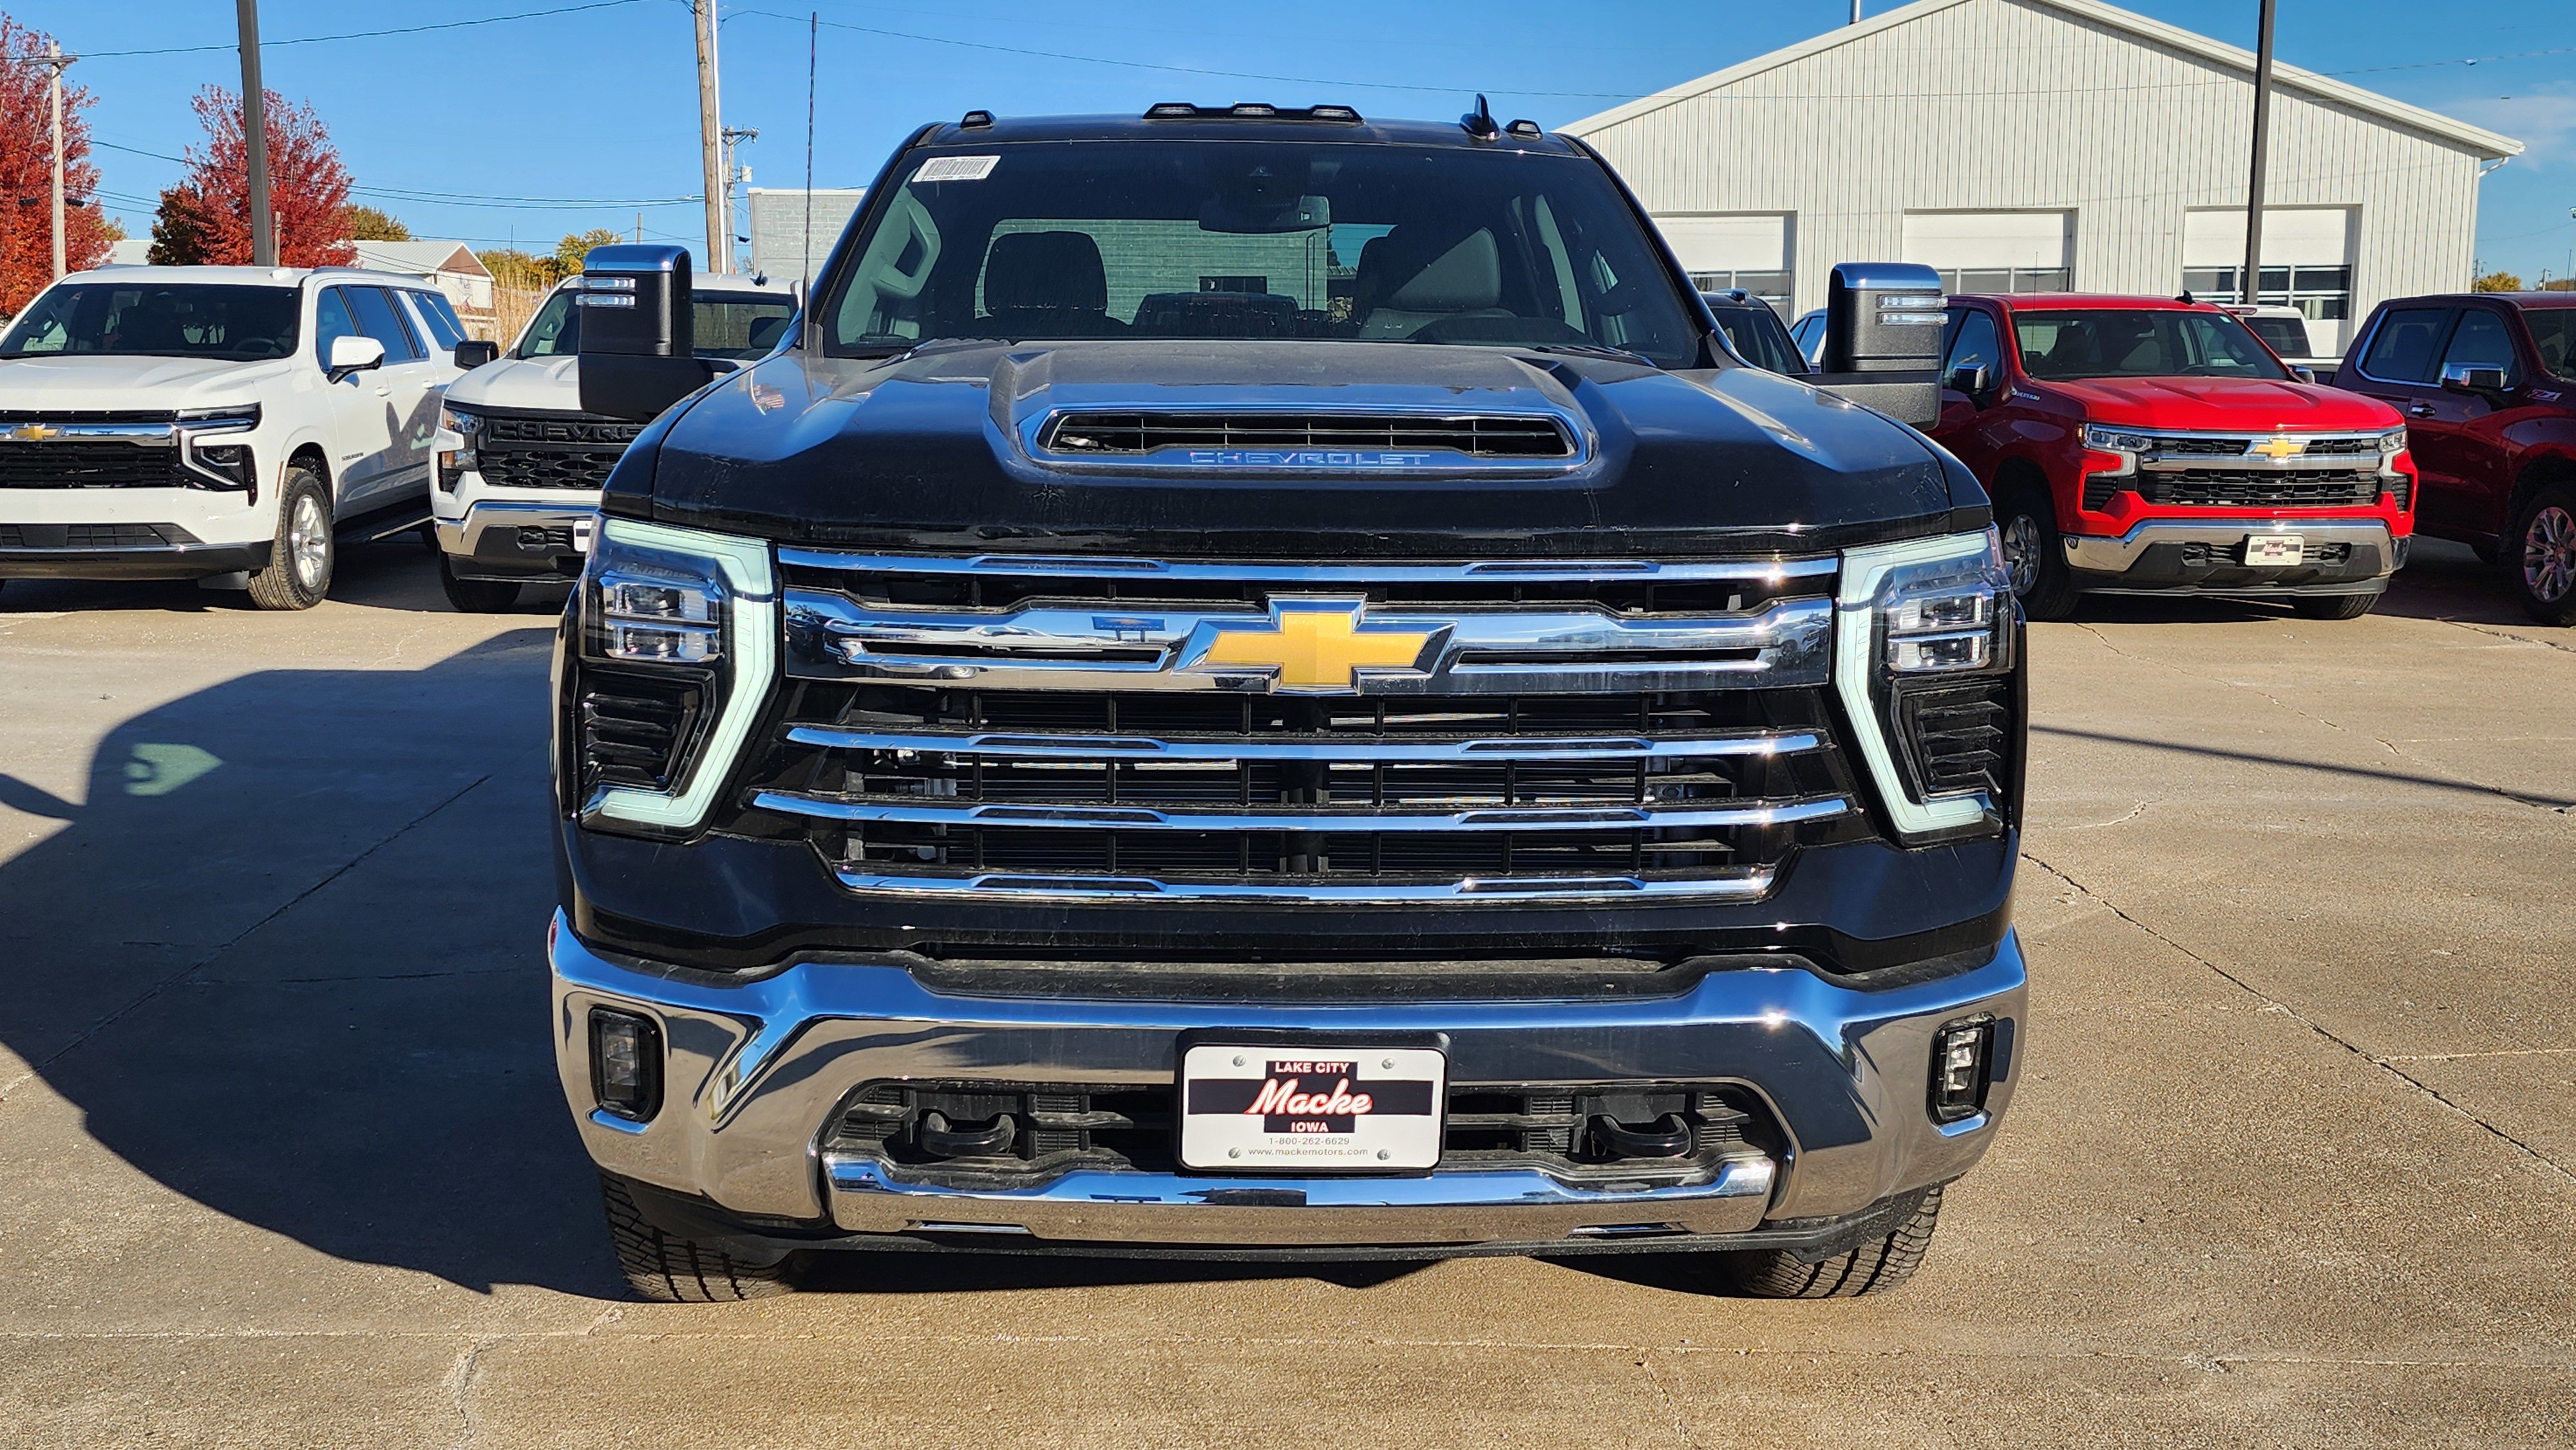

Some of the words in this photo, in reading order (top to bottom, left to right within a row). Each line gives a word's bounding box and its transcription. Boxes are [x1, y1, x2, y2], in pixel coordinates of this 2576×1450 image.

[490, 420, 648, 440] CHEVRO
[1189, 451, 1430, 465] CHEVROLET
[1274, 1062, 1312, 1073] LAKE
[1315, 1062, 1350, 1073] CITY
[1244, 1077, 1373, 1116] Macke
[1291, 1122, 1329, 1133] IOWA
